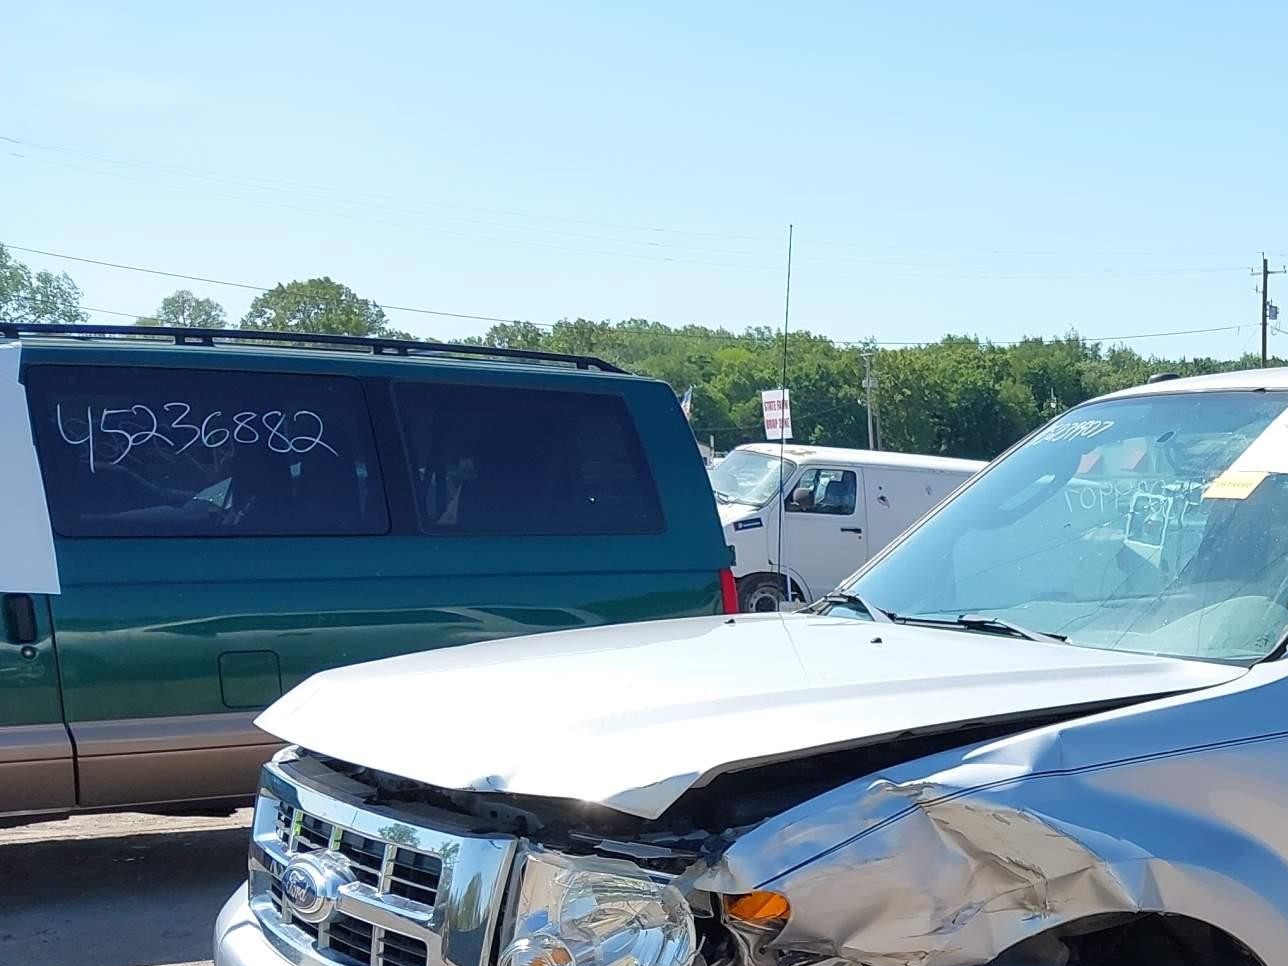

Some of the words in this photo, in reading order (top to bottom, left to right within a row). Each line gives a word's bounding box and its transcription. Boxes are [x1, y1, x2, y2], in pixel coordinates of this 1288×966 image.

[777, 400, 788, 410] FAM
[779, 417, 790, 428] ZNE
[57, 402, 340, 473] 45236882
[286, 870, 310, 902] Ford
